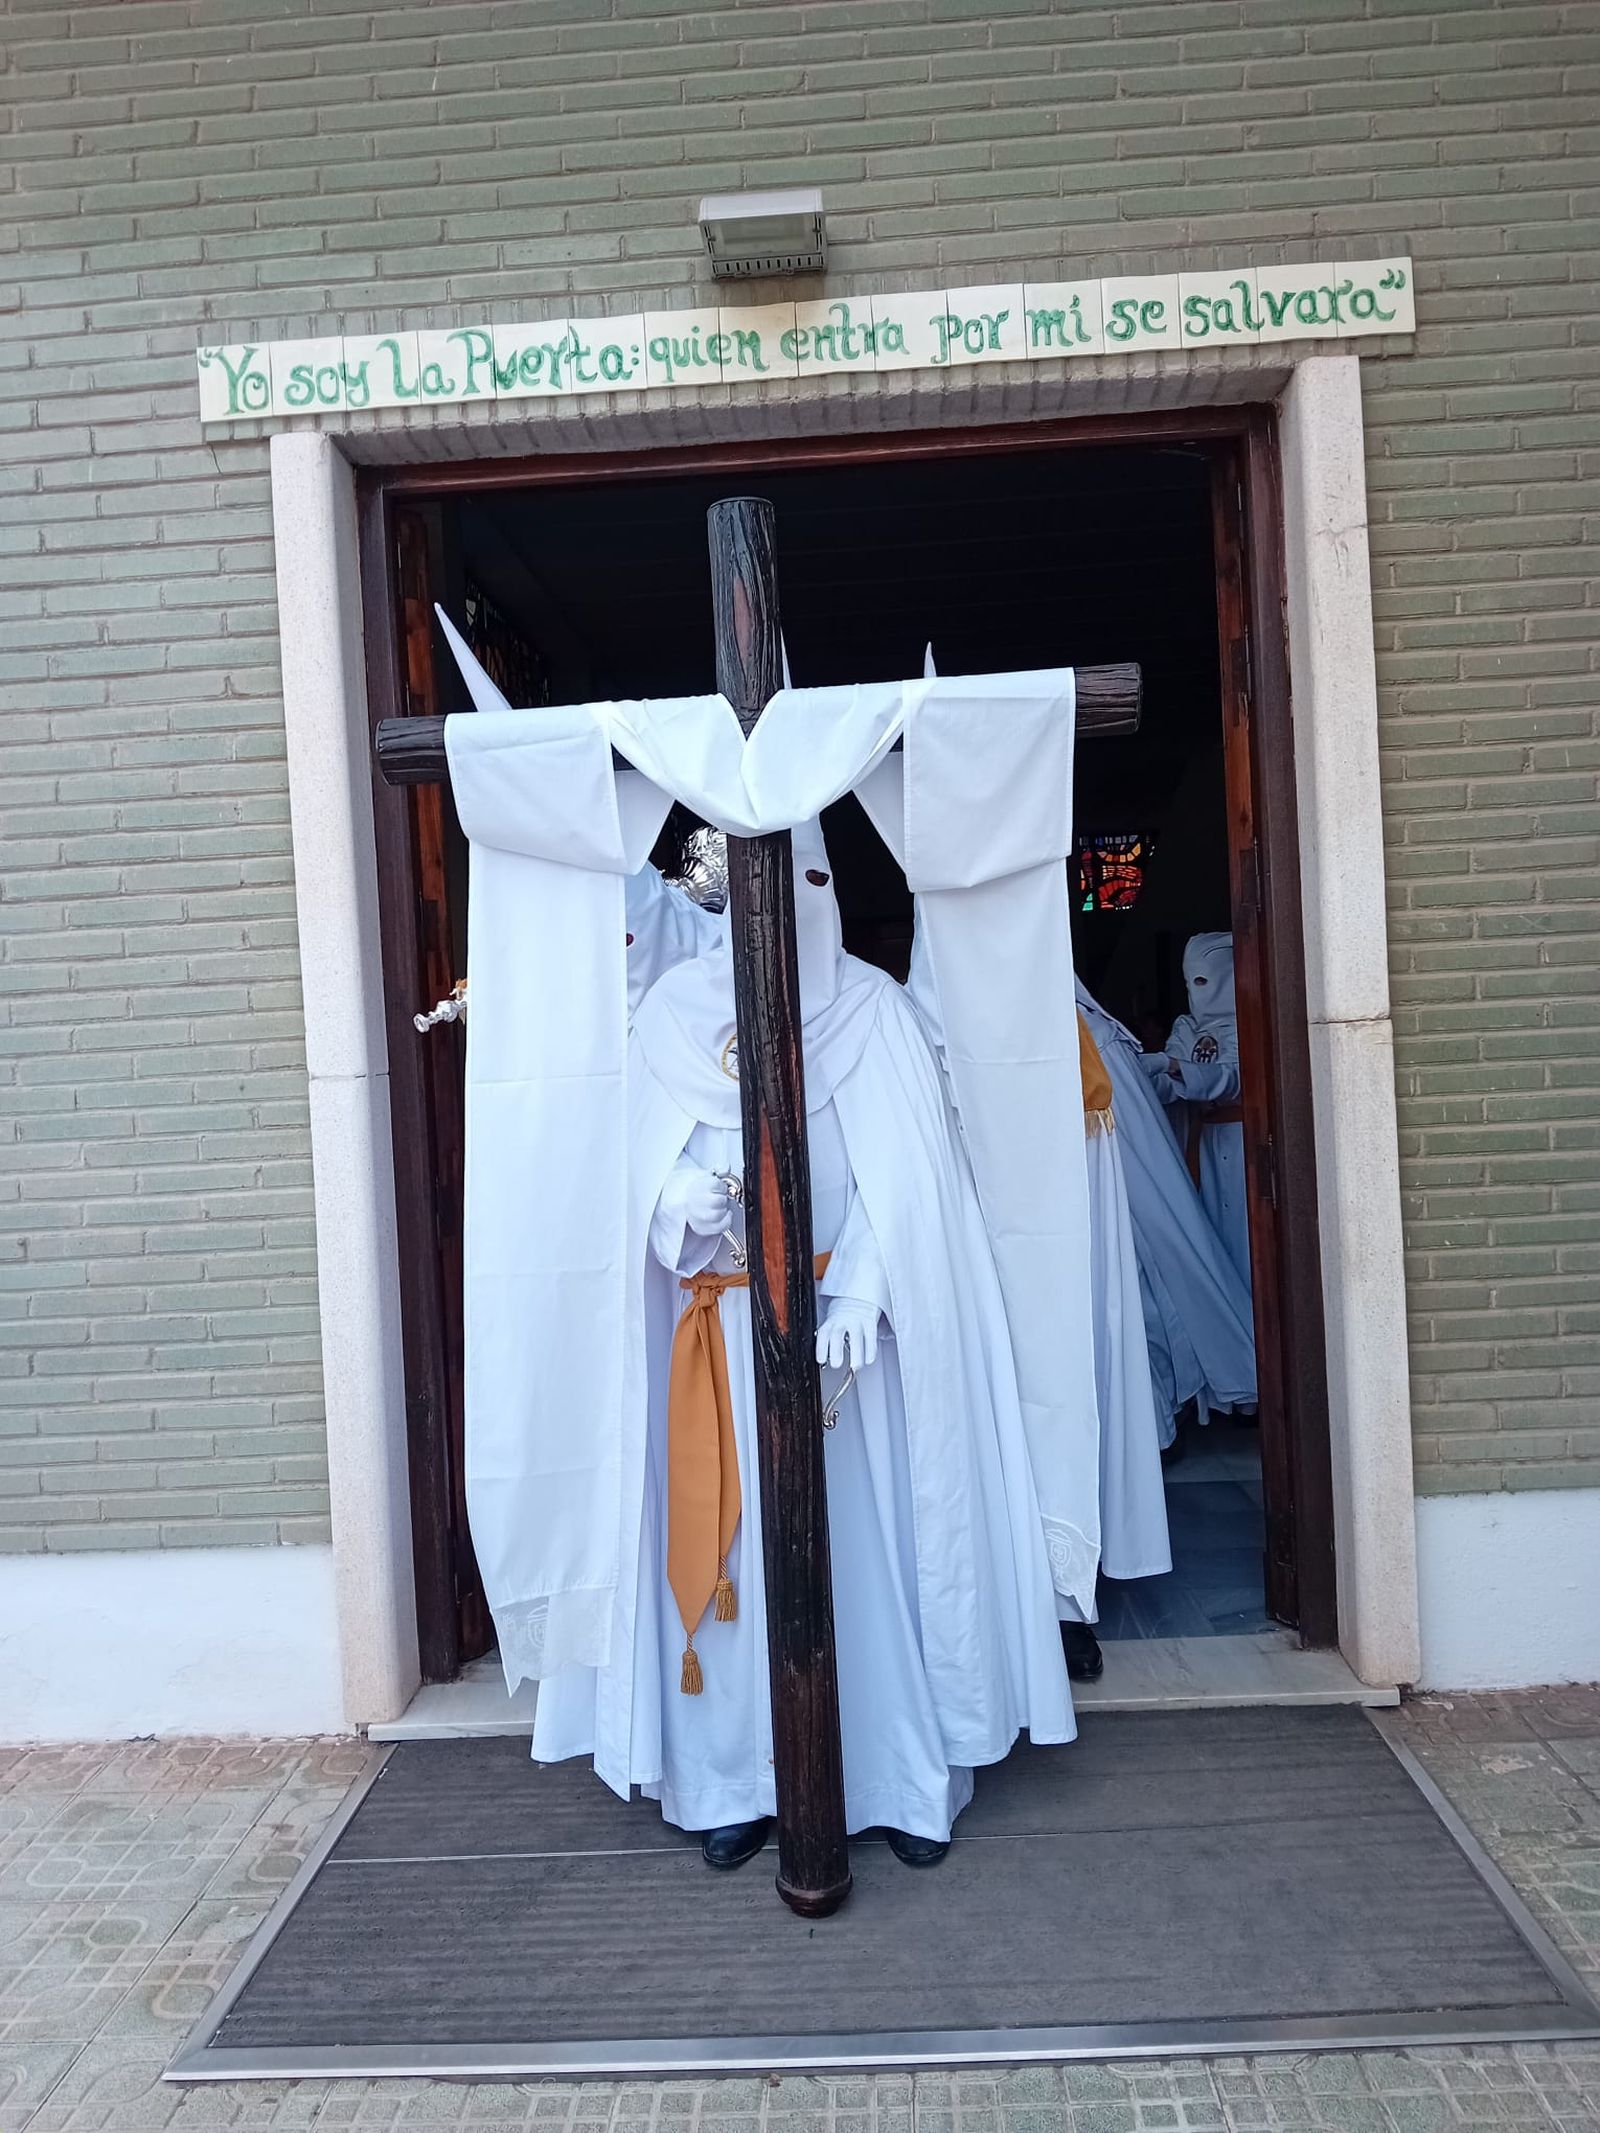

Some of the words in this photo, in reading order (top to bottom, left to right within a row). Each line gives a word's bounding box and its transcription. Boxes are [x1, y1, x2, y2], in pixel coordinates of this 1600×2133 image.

[283, 358, 370, 408] soy
[648, 325, 770, 384] quien
[780, 302, 910, 363] entra
[929, 308, 1010, 364] por
[1105, 299, 1167, 342] se
